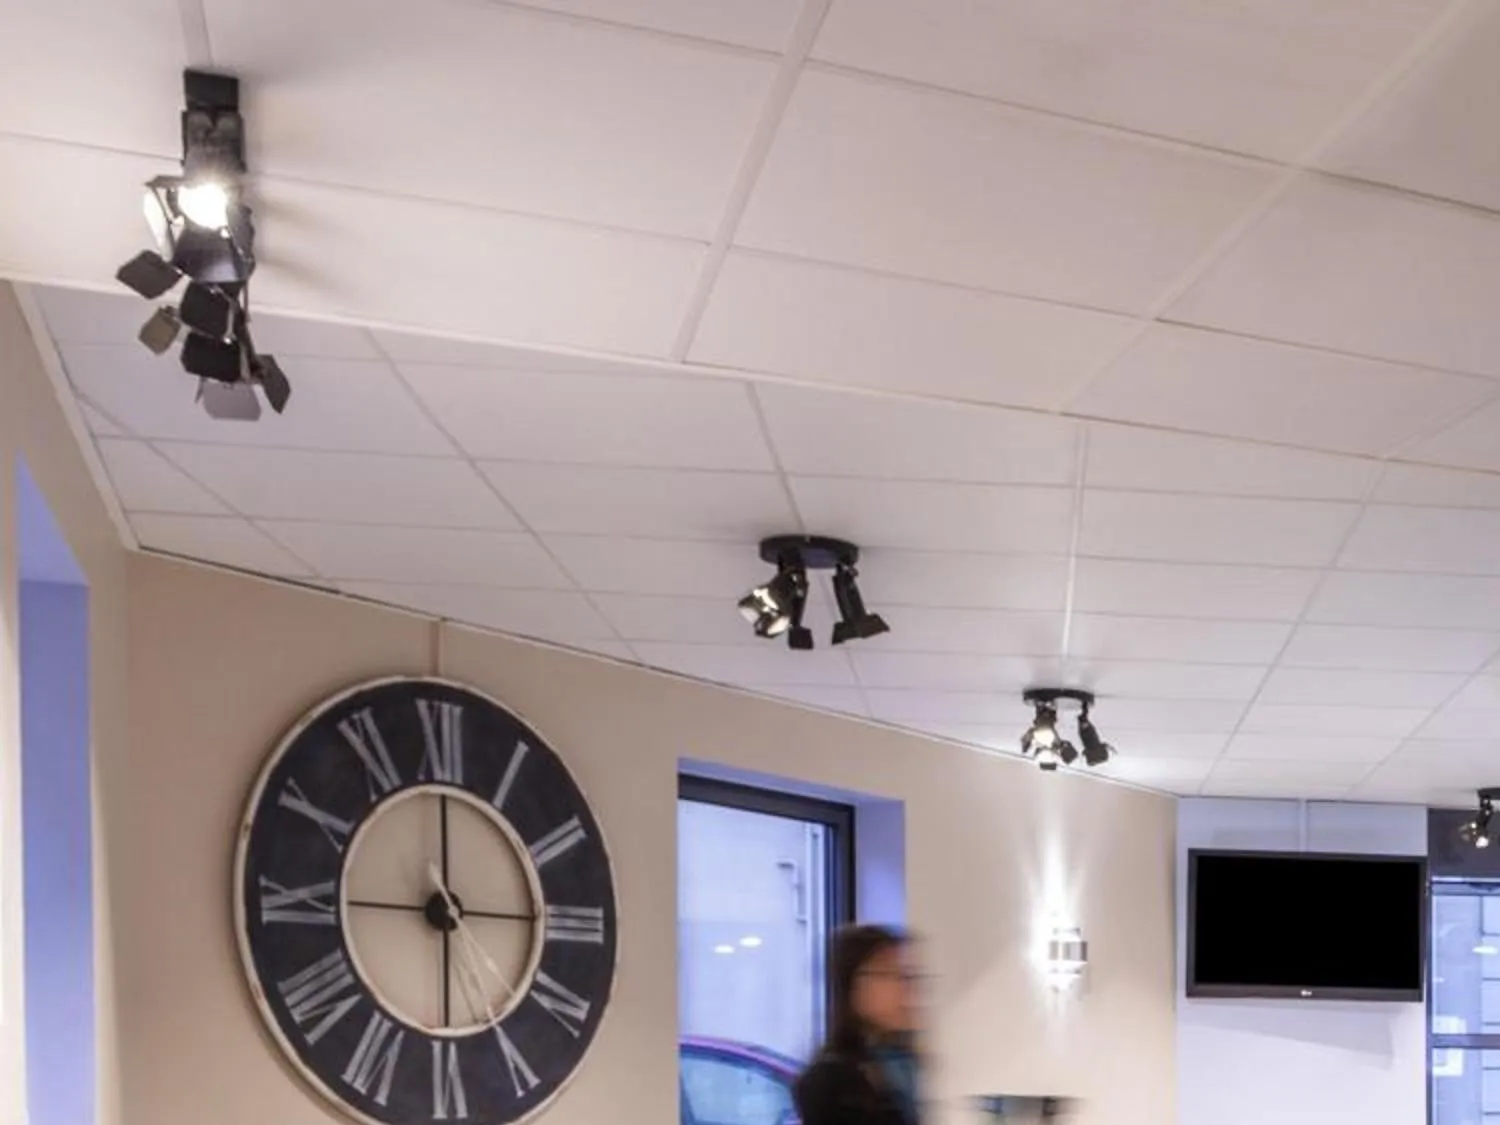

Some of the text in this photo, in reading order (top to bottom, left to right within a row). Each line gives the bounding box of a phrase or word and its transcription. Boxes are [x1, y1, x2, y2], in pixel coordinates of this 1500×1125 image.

[336, 706, 403, 804] XI
[416, 698, 464, 785] XII
[493, 740, 530, 810] I
[278, 776, 356, 854] X
[529, 813, 587, 869] II
[258, 874, 337, 926] IX
[545, 904, 604, 944] III
[530, 969, 591, 1039] IV
[341, 1009, 405, 1106] VII
[431, 1040, 468, 1119] VI
[494, 1023, 542, 1098] V
